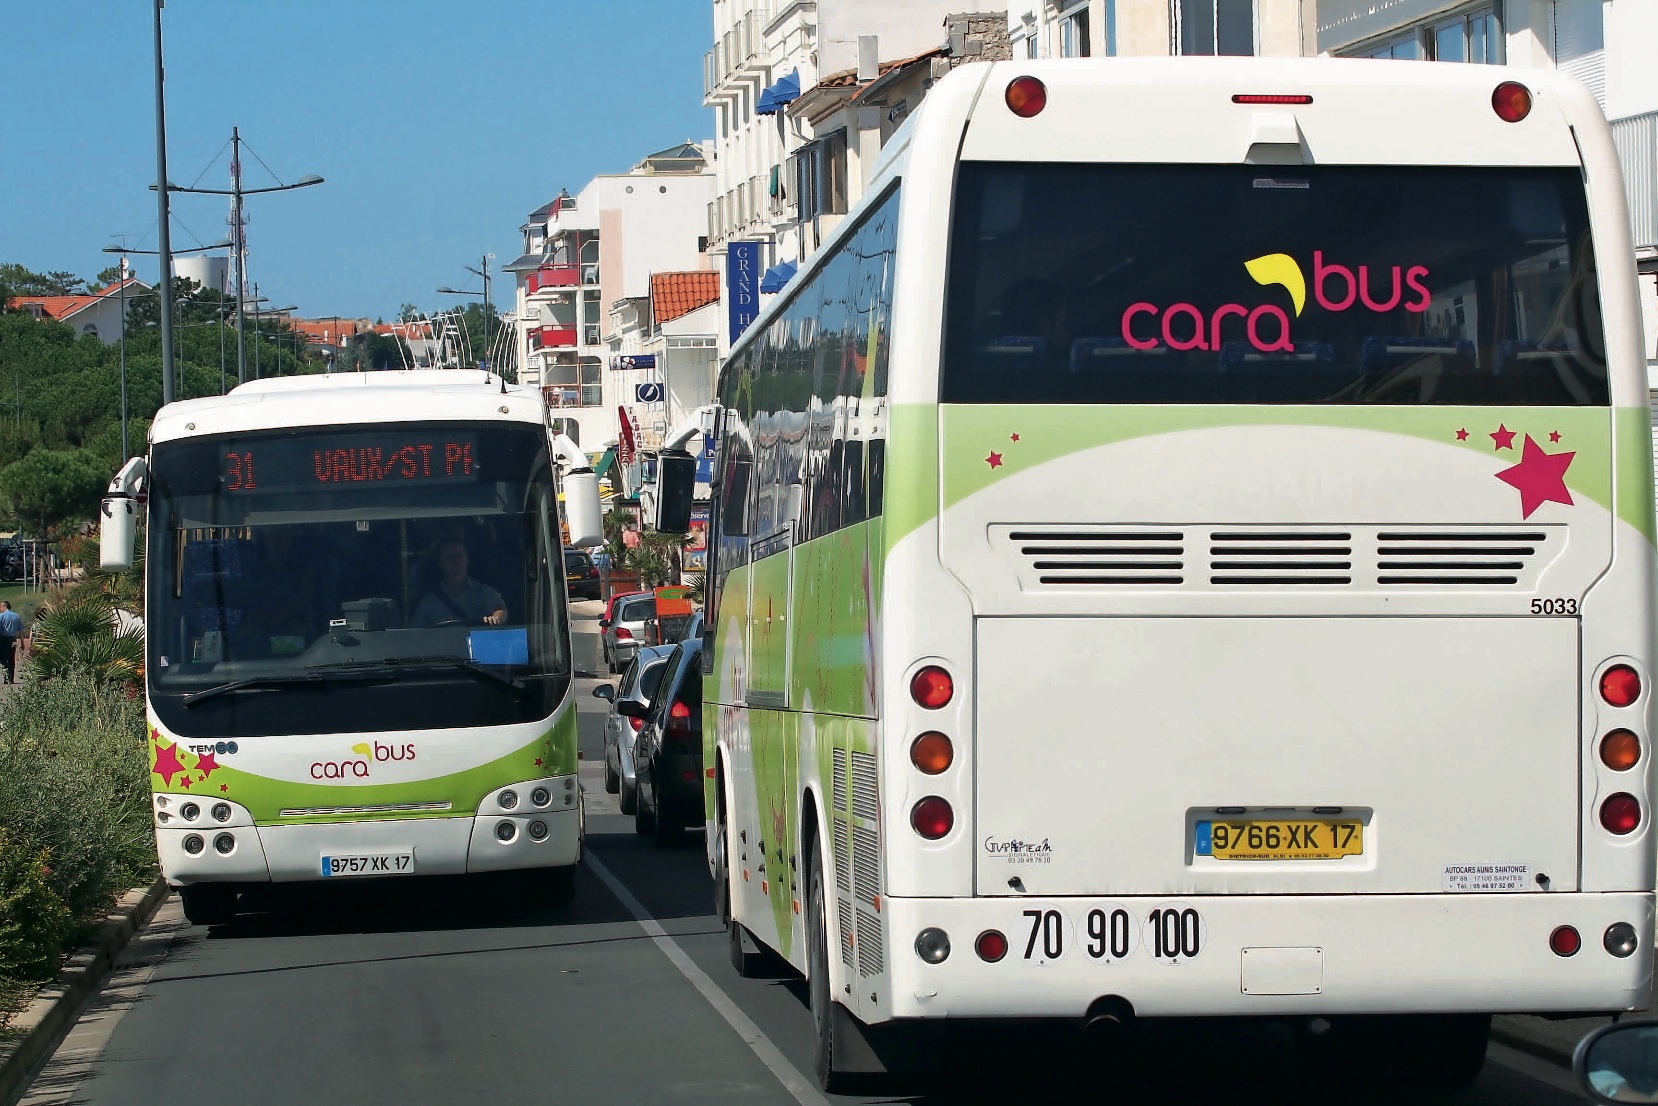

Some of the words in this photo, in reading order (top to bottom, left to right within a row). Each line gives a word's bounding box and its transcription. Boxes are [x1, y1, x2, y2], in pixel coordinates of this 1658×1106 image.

[737, 246, 751, 305] GRAND
[1313, 250, 1431, 313] bus
[628, 406, 643, 449] TABAC
[226, 452, 257, 490] 31
[1530, 598, 1578, 615] 5033
[374, 740, 416, 761] bus
[1213, 825, 1280, 850] 9766
[1287, 825, 1319, 849] XK
[1330, 825, 1356, 849] 17
[331, 857, 368, 873] 9757
[371, 857, 390, 871] XK
[395, 856, 410, 870] 17
[1445, 866, 1476, 874] AUTOCARS
[1022, 909, 1063, 960] 70
[1087, 908, 1129, 958] 90
[1148, 908, 1200, 958] 100
